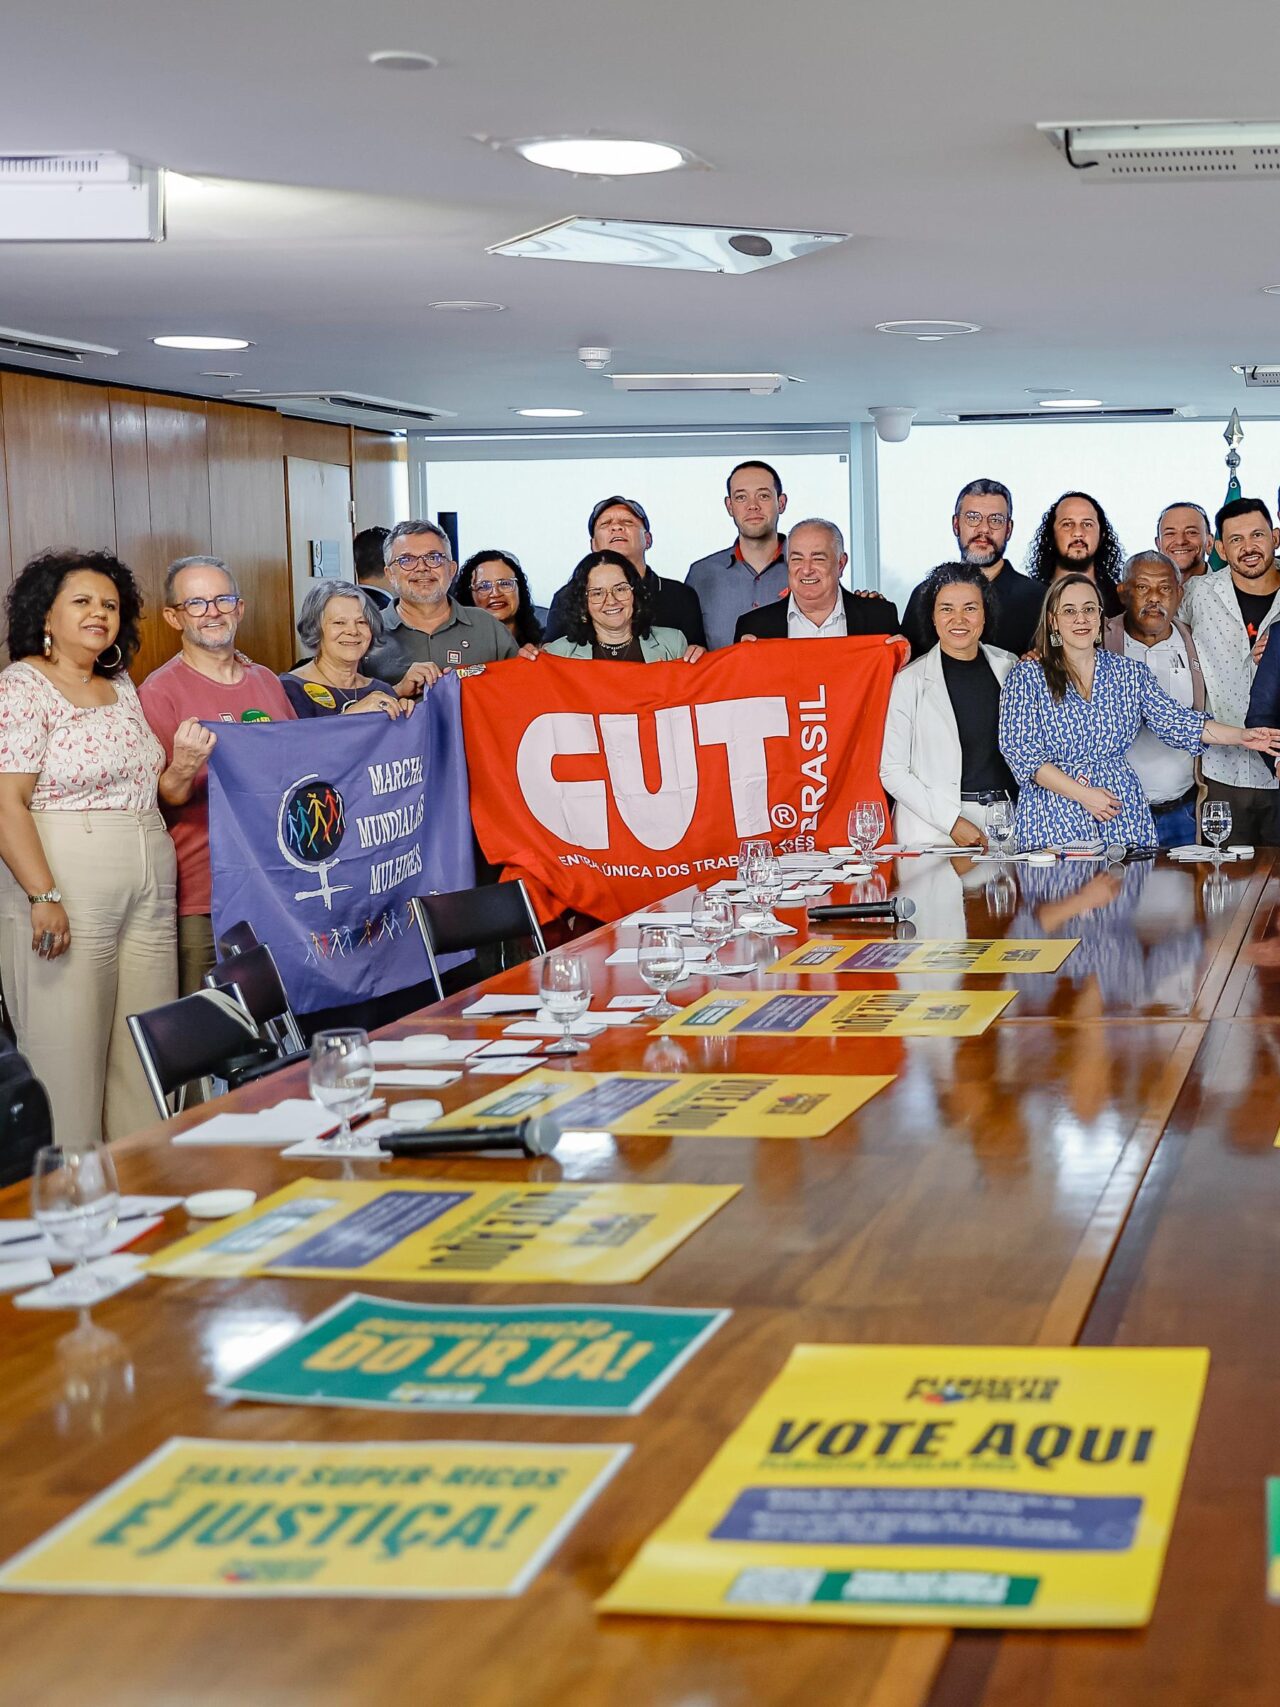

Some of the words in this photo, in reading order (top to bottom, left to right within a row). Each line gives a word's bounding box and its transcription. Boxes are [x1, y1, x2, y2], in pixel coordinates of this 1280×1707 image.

[516, 696, 790, 850] CUT
[602, 862, 653, 878] ÚNICA
[656, 865, 690, 878] DOS
[303, 1334, 436, 1375] DO
[426, 1337, 531, 1380] IR
[507, 1329, 656, 1387] JÁ!
[768, 1418, 954, 1457] VOTE
[971, 1421, 1157, 1471] AQUI
[299, 1464, 569, 1490] SUPER-RICOS
[136, 1502, 539, 1561] JUSTIÇA!
